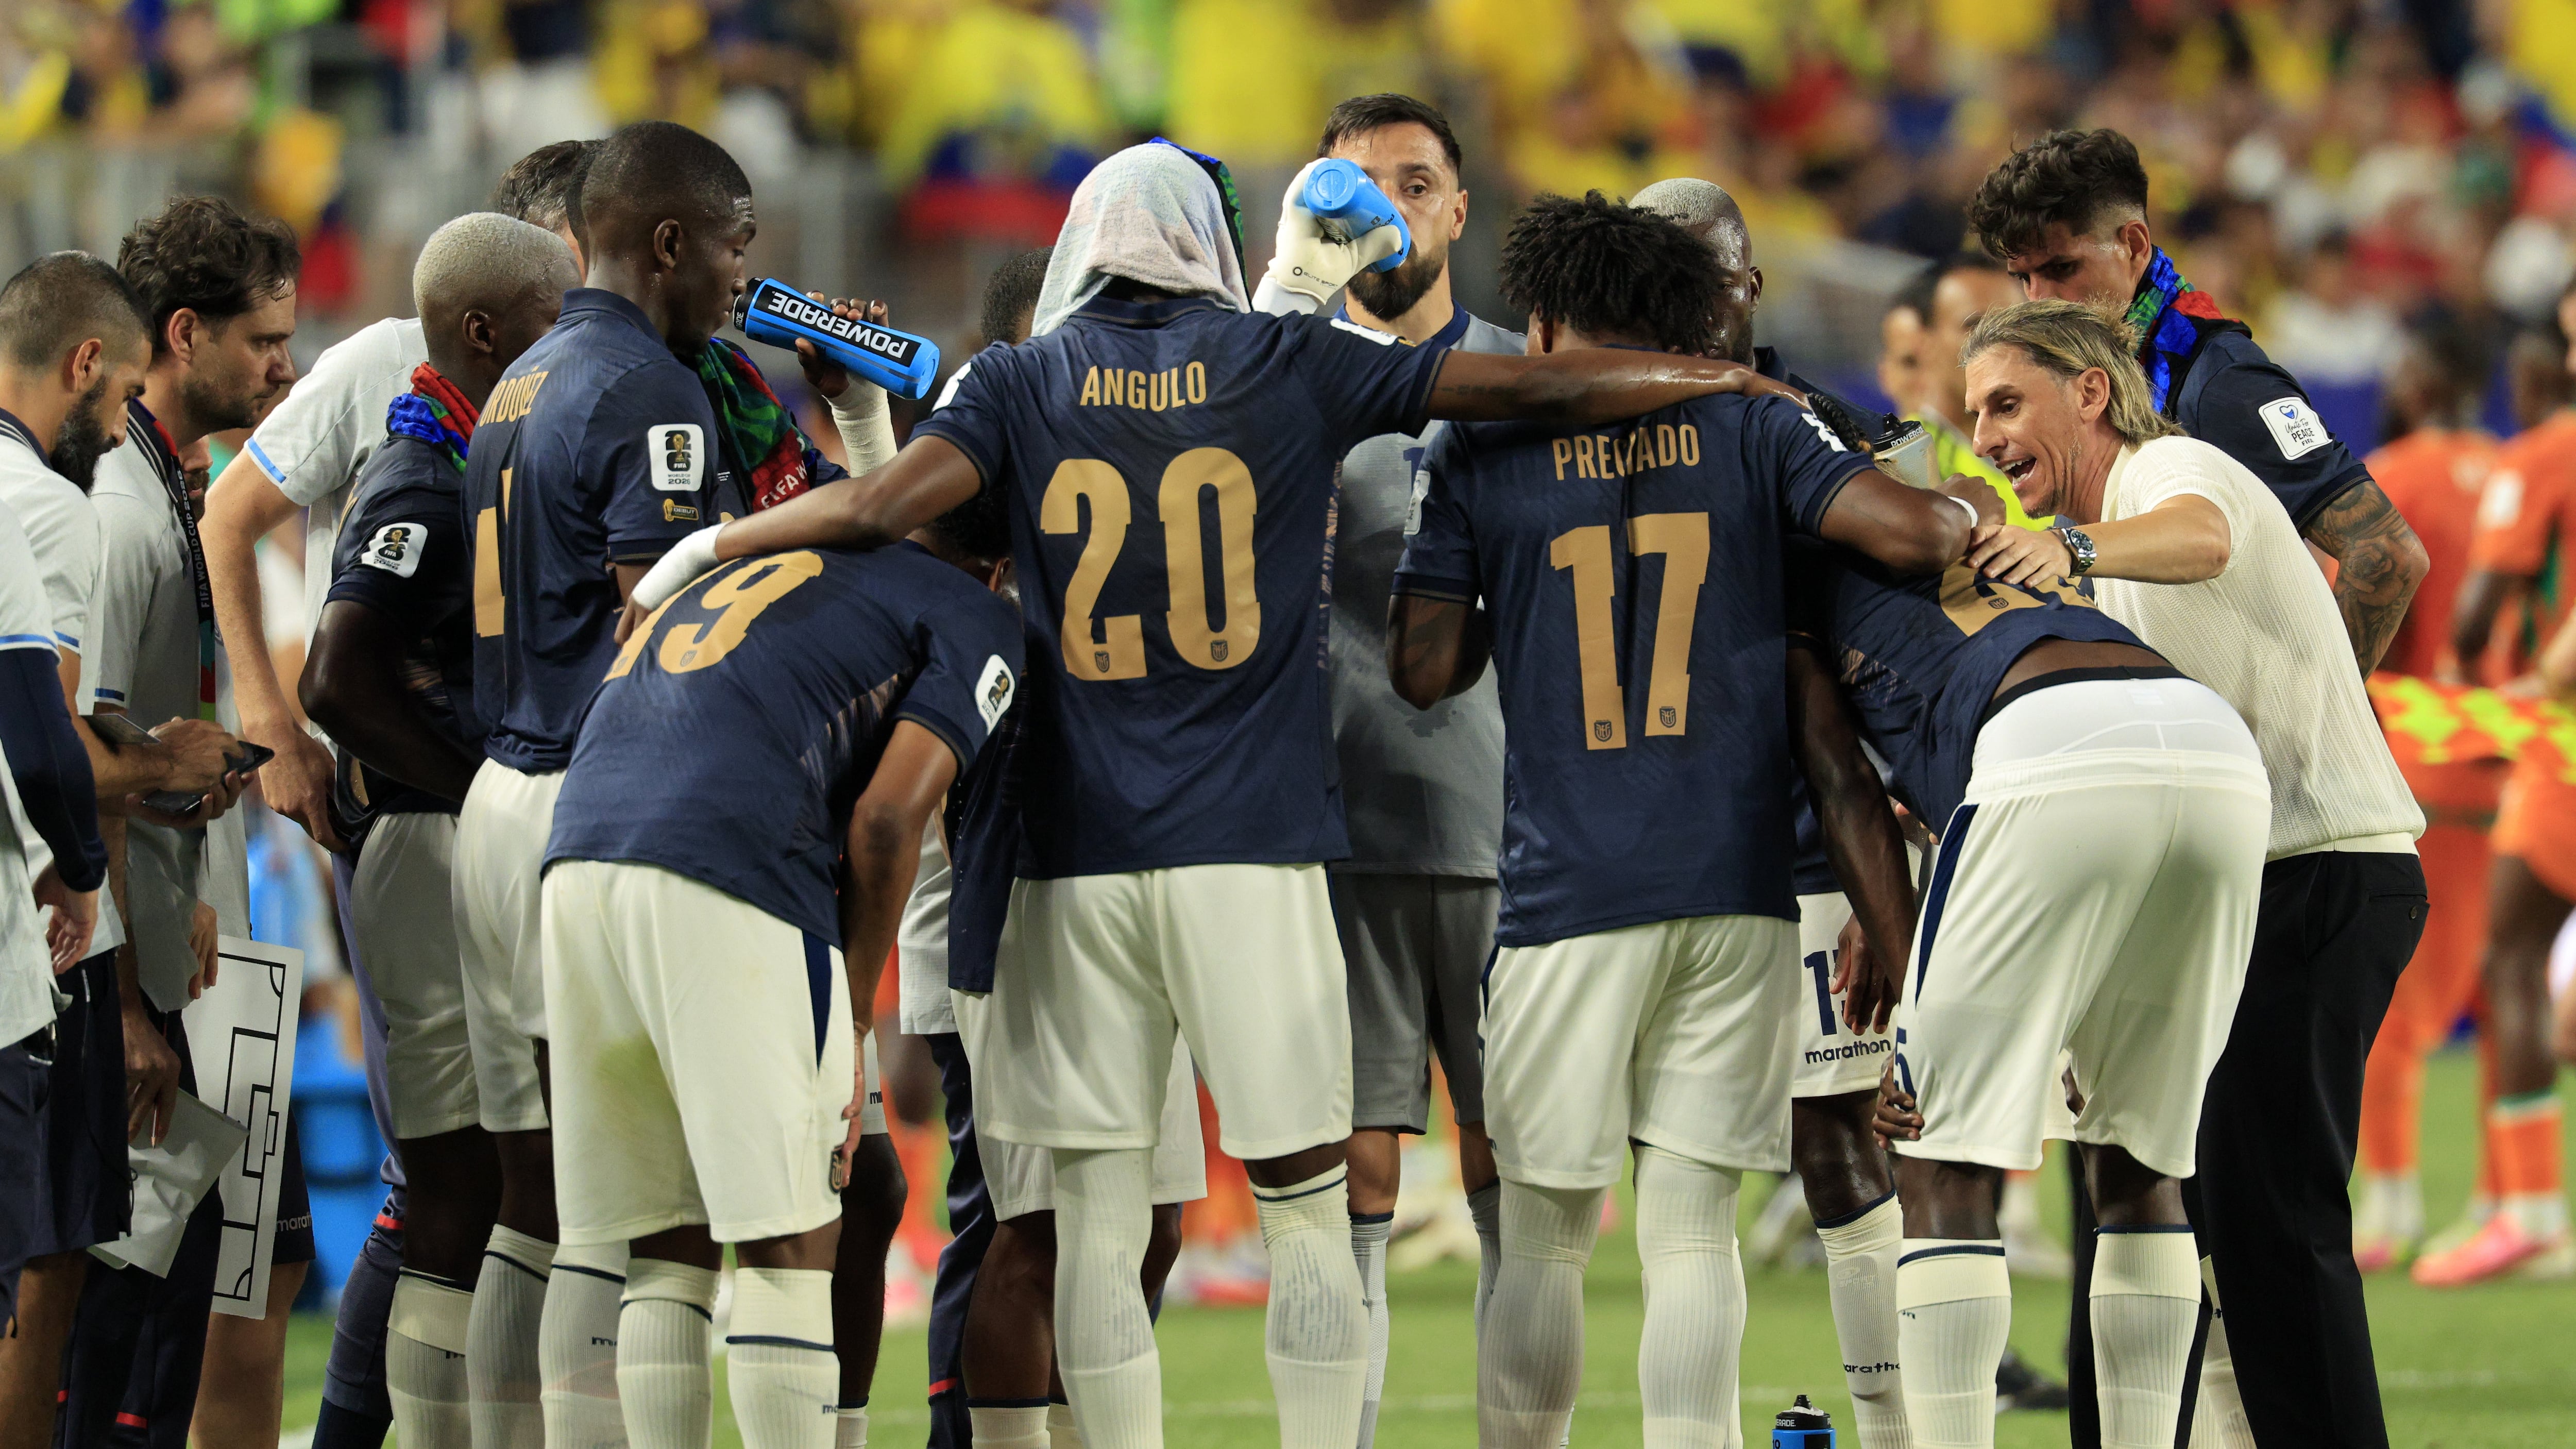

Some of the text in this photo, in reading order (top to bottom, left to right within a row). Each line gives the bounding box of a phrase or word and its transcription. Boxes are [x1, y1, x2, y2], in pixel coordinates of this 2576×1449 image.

[768, 291, 909, 359] POWERADE
[1080, 361, 1207, 412] ANGULO
[2285, 418, 2309, 433] Unite For
[2292, 428, 2315, 442] PEACE
[761, 474, 799, 508] FIFA
[187, 512, 196, 536] CUP
[191, 538, 206, 581] WORLD
[1040, 447, 1261, 681] 20
[198, 583, 210, 608] FIFA
[1550, 512, 1710, 750] 17
[1805, 1039, 1891, 1064] marathon
